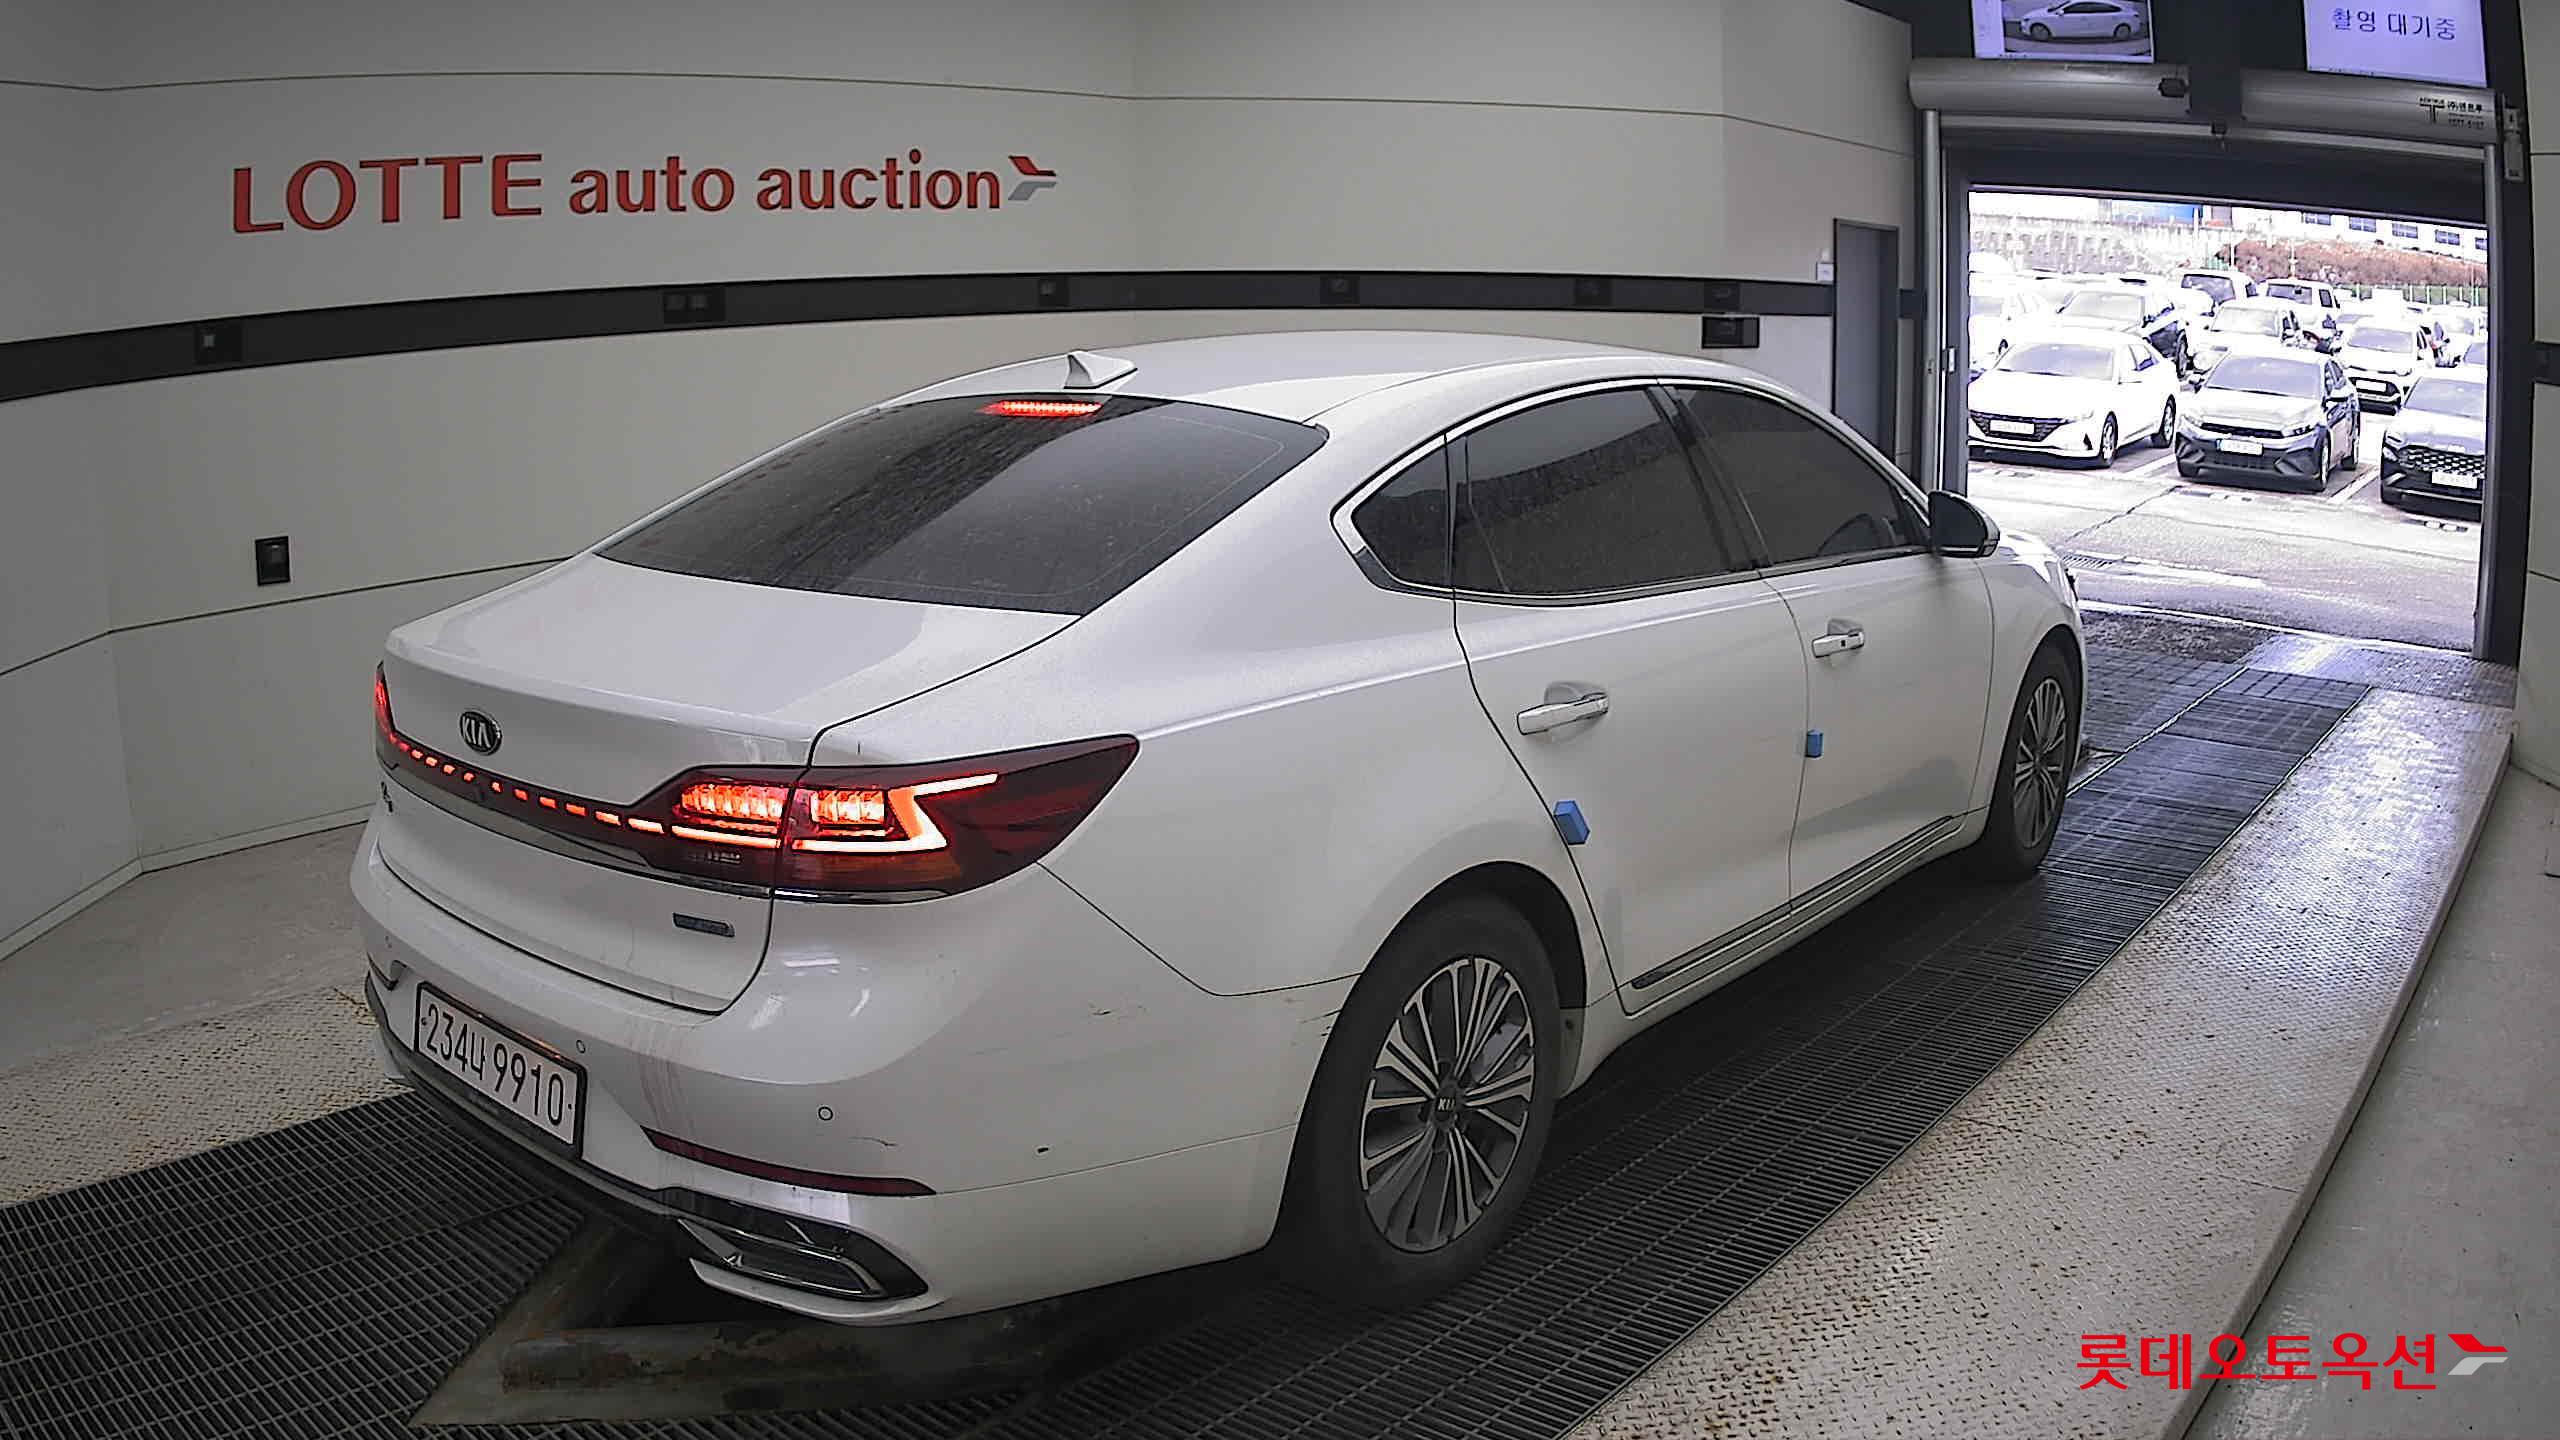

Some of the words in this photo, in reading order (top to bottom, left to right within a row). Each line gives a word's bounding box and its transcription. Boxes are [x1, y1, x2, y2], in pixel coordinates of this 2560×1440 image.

[2333, 8, 2376, 33] 촬영
[2387, 13, 2456, 41] 대기중
[233, 153, 542, 234] LOTTE
[568, 155, 735, 214] auto
[756, 149, 1001, 210] auction
[493, 1043, 565, 1127] 9910
